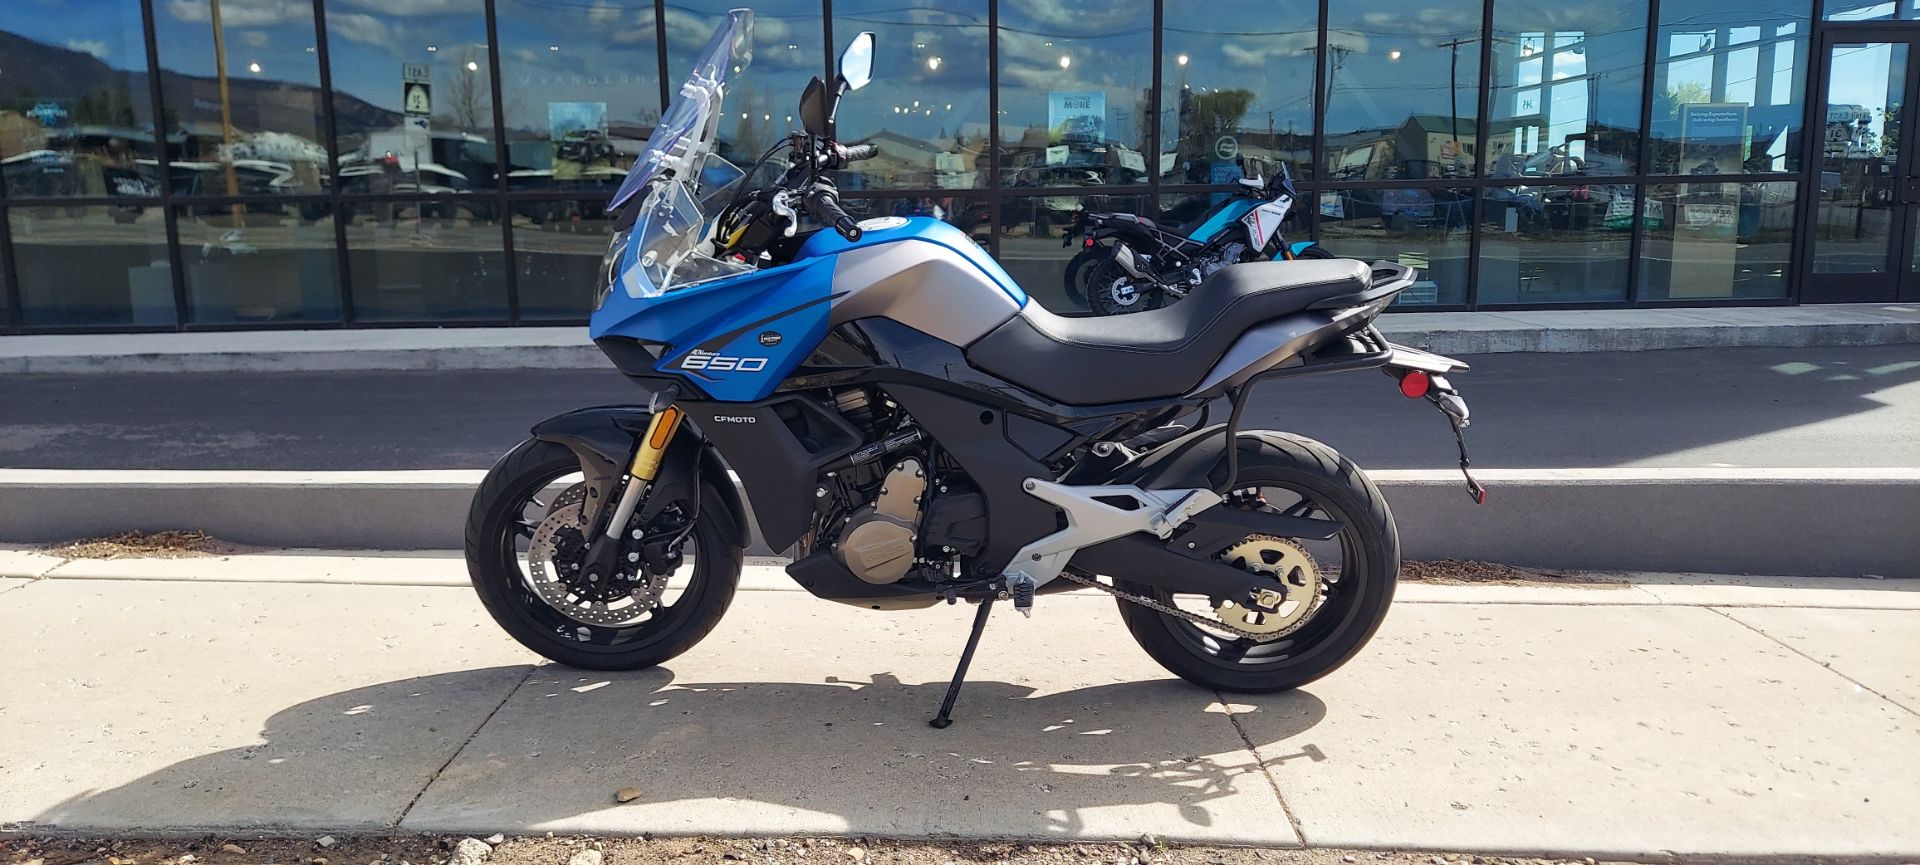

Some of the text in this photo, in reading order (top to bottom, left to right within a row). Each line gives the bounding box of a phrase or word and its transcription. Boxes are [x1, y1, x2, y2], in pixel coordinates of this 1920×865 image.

[1064, 101, 1091, 109] MORE
[681, 355, 769, 372] 650
[714, 415, 756, 424] CFMOTO
